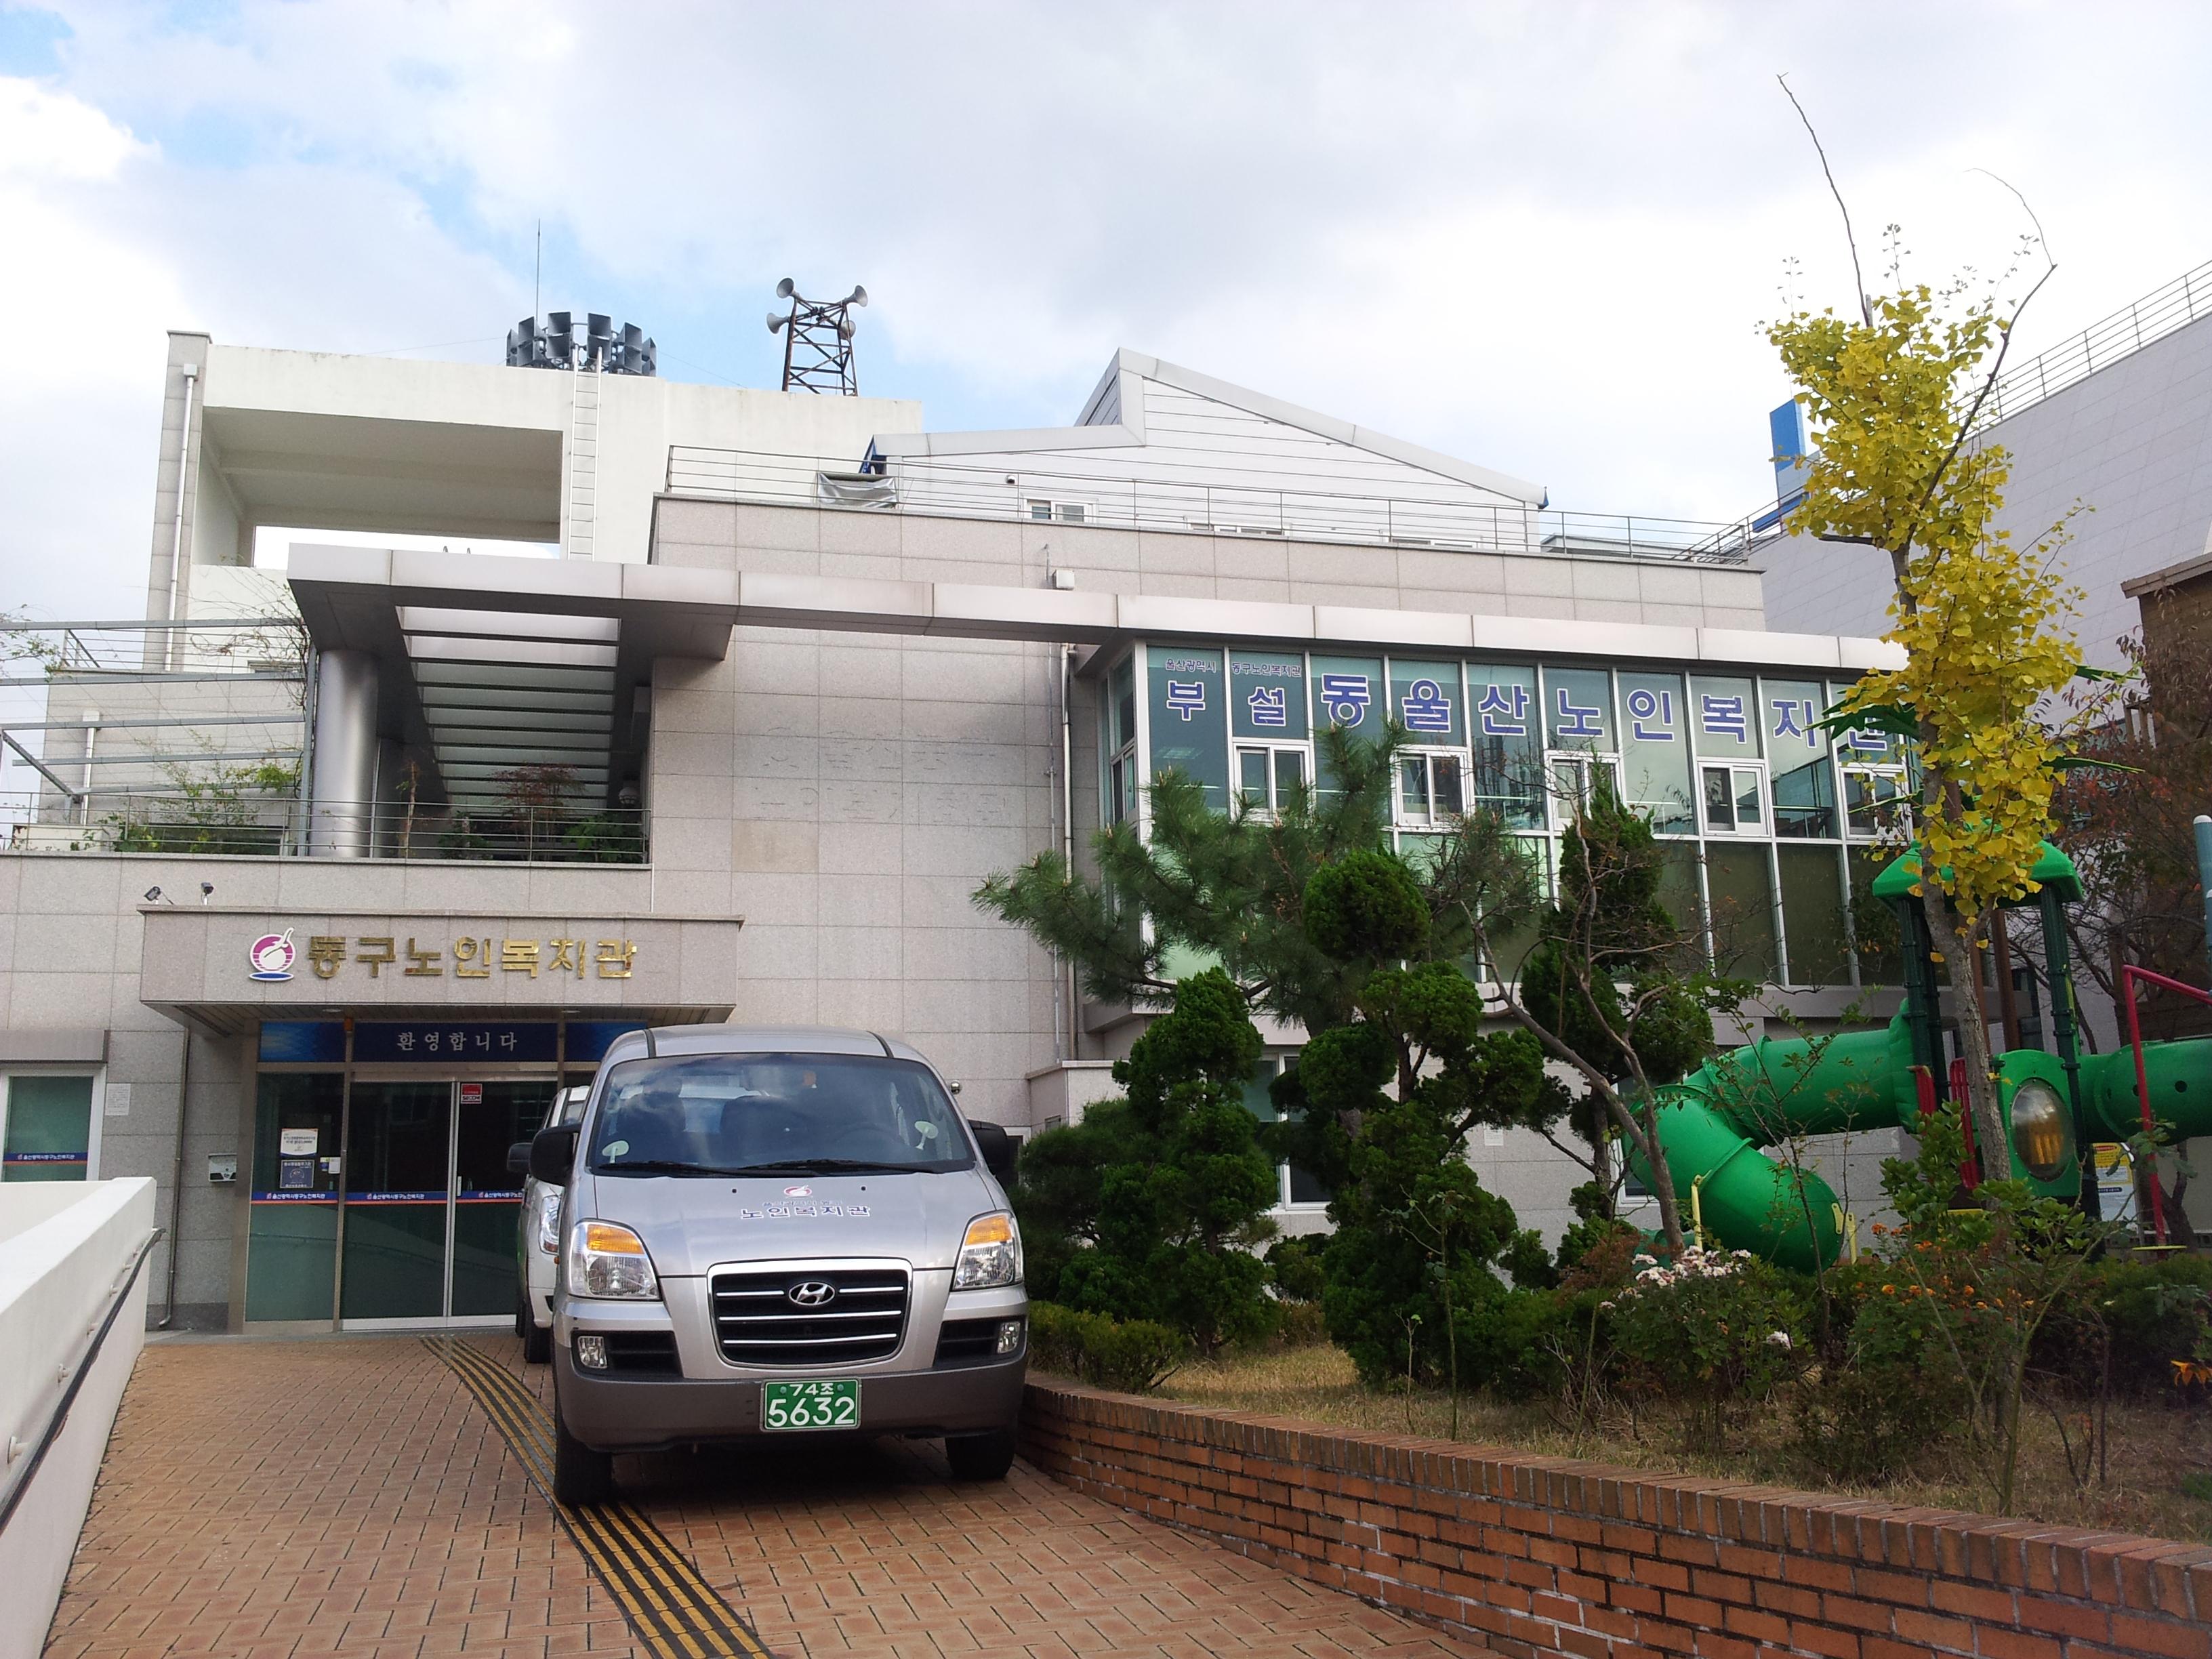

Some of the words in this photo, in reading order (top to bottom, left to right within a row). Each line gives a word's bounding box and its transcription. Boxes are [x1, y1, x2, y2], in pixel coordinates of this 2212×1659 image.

[1166, 658, 1216, 673] 울산광역시
[1232, 662, 1301, 677] 동구노인복지관
[1166, 680, 1286, 726] 부설
[308, 935, 638, 979] 동구노인복지관
[396, 1031, 518, 1052] 환영합니다
[741, 1204, 871, 1220] 노인복지관
[790, 1382, 834, 1396] 74조
[767, 1396, 855, 1427] 5632
